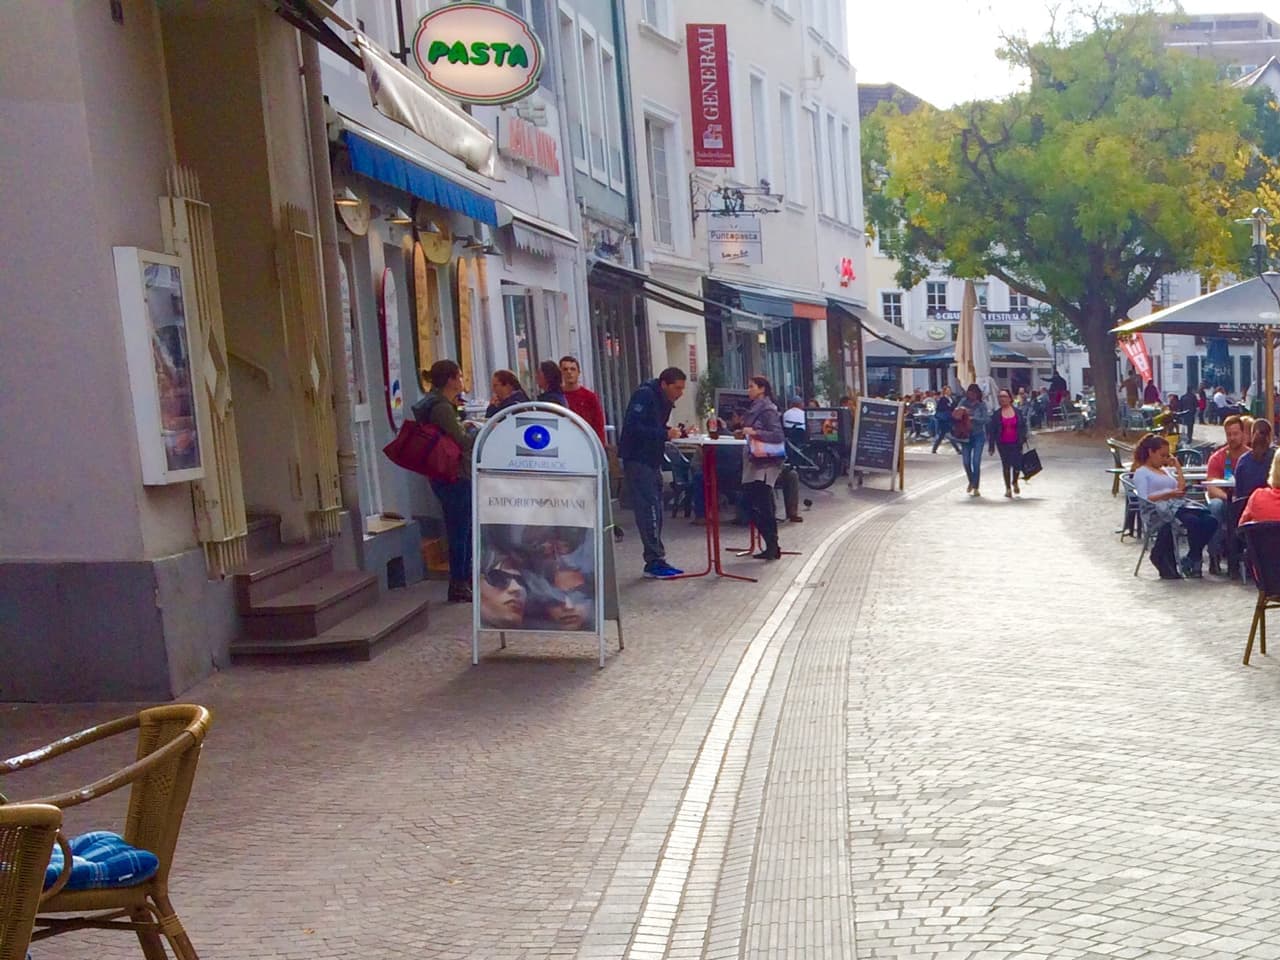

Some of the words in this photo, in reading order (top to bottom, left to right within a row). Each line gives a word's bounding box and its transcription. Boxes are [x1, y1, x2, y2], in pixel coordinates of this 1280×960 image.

[428, 40, 528, 68] PASTA
[699, 27, 720, 121] GENERALI
[988, 312, 1019, 321] FESTIVAL
[488, 496, 538, 508] EMPORIO
[549, 499, 586, 511] ARMANI
